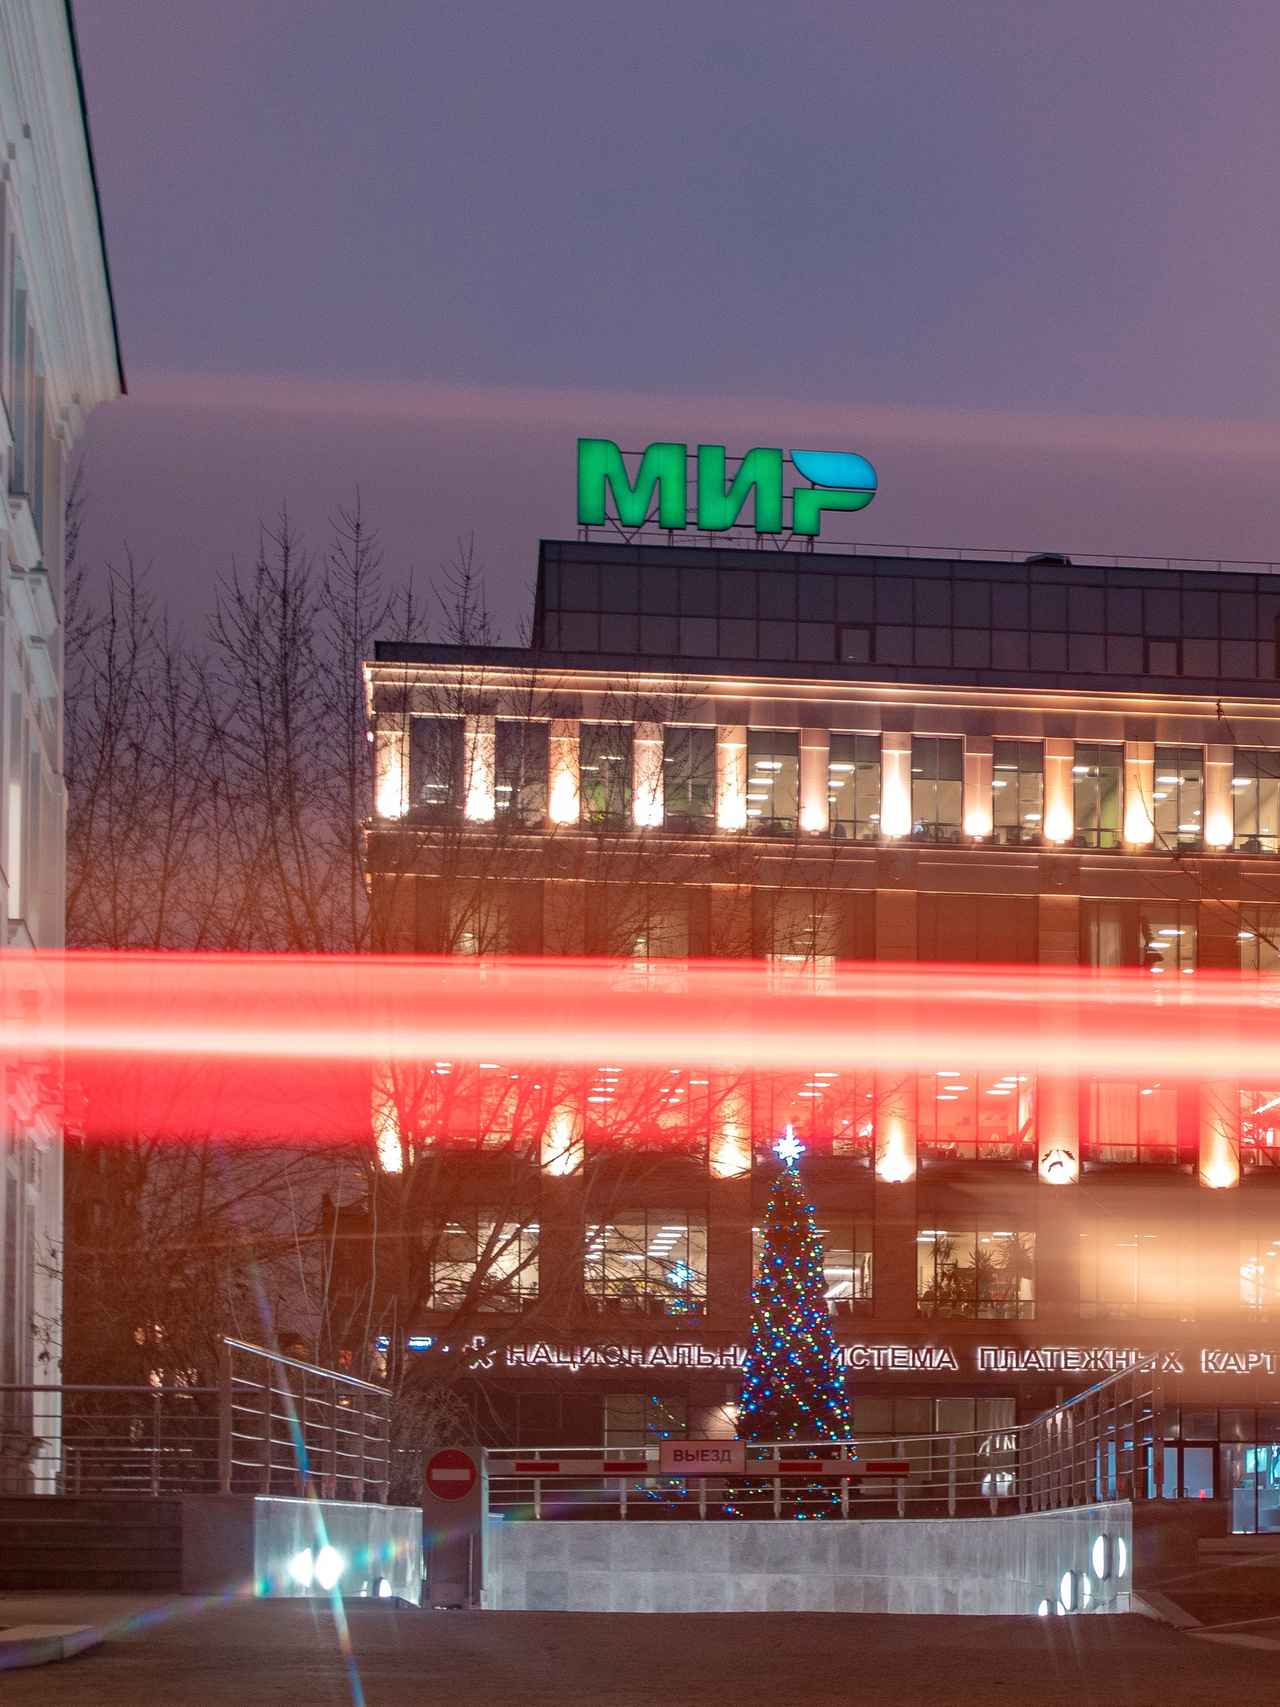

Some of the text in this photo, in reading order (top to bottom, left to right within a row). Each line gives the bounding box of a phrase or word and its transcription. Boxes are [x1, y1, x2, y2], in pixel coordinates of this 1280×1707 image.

[577, 438, 878, 536] МИР
[507, 1342, 748, 1371] НАЦИОНАЛЬН
[830, 1345, 959, 1370] ИСТЕМА
[1201, 1349, 1280, 1374] КАРТ
[673, 1449, 732, 1464] ВЫЕЗД
